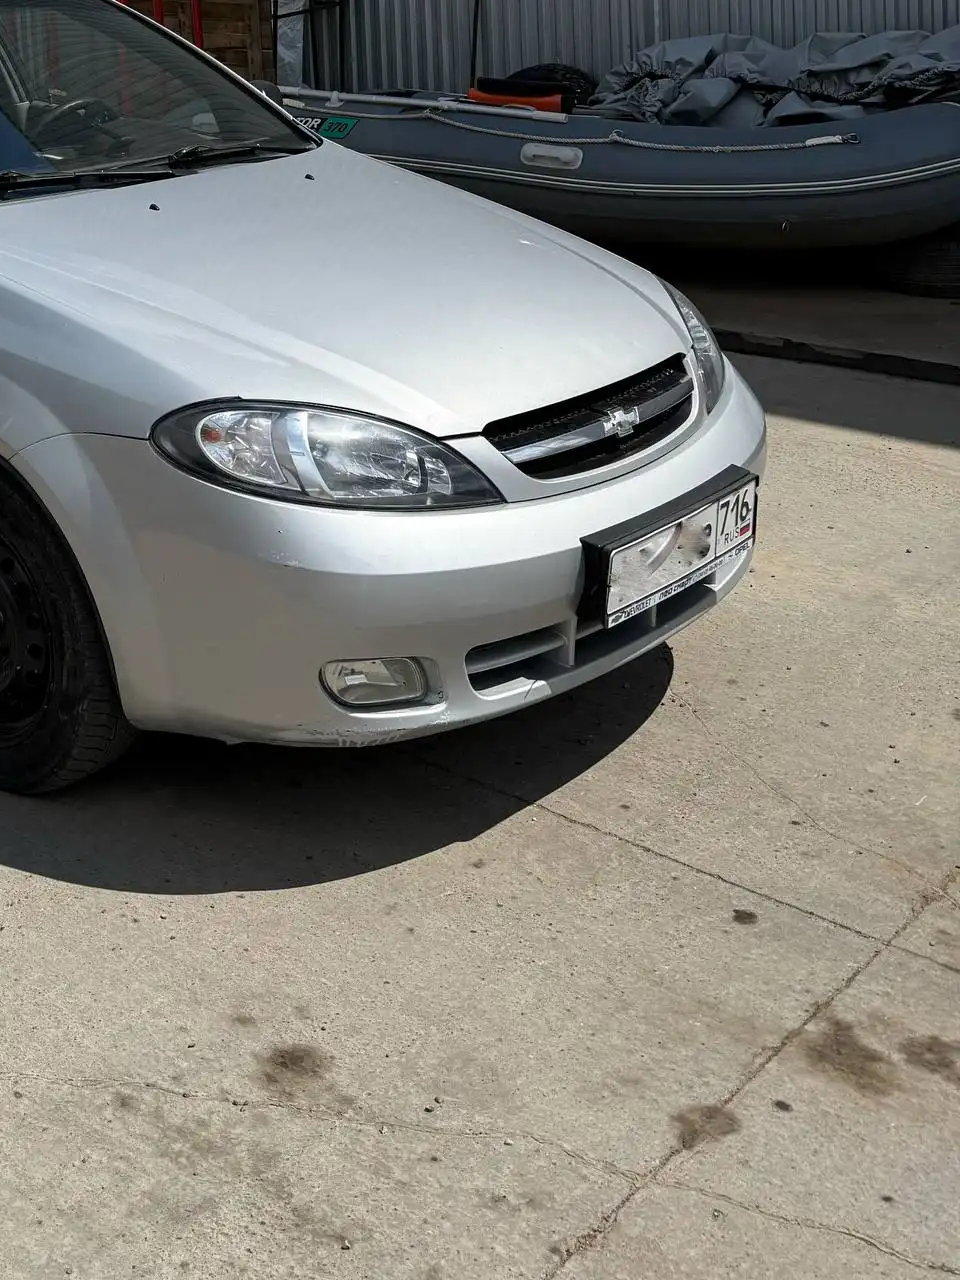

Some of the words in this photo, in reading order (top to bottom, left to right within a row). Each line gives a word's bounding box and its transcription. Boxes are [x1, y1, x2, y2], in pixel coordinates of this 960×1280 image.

[324, 122, 348, 132] 370
[719, 489, 750, 536] 716
[724, 526, 740, 545] RUS
[734, 542, 750, 556] OPEL
